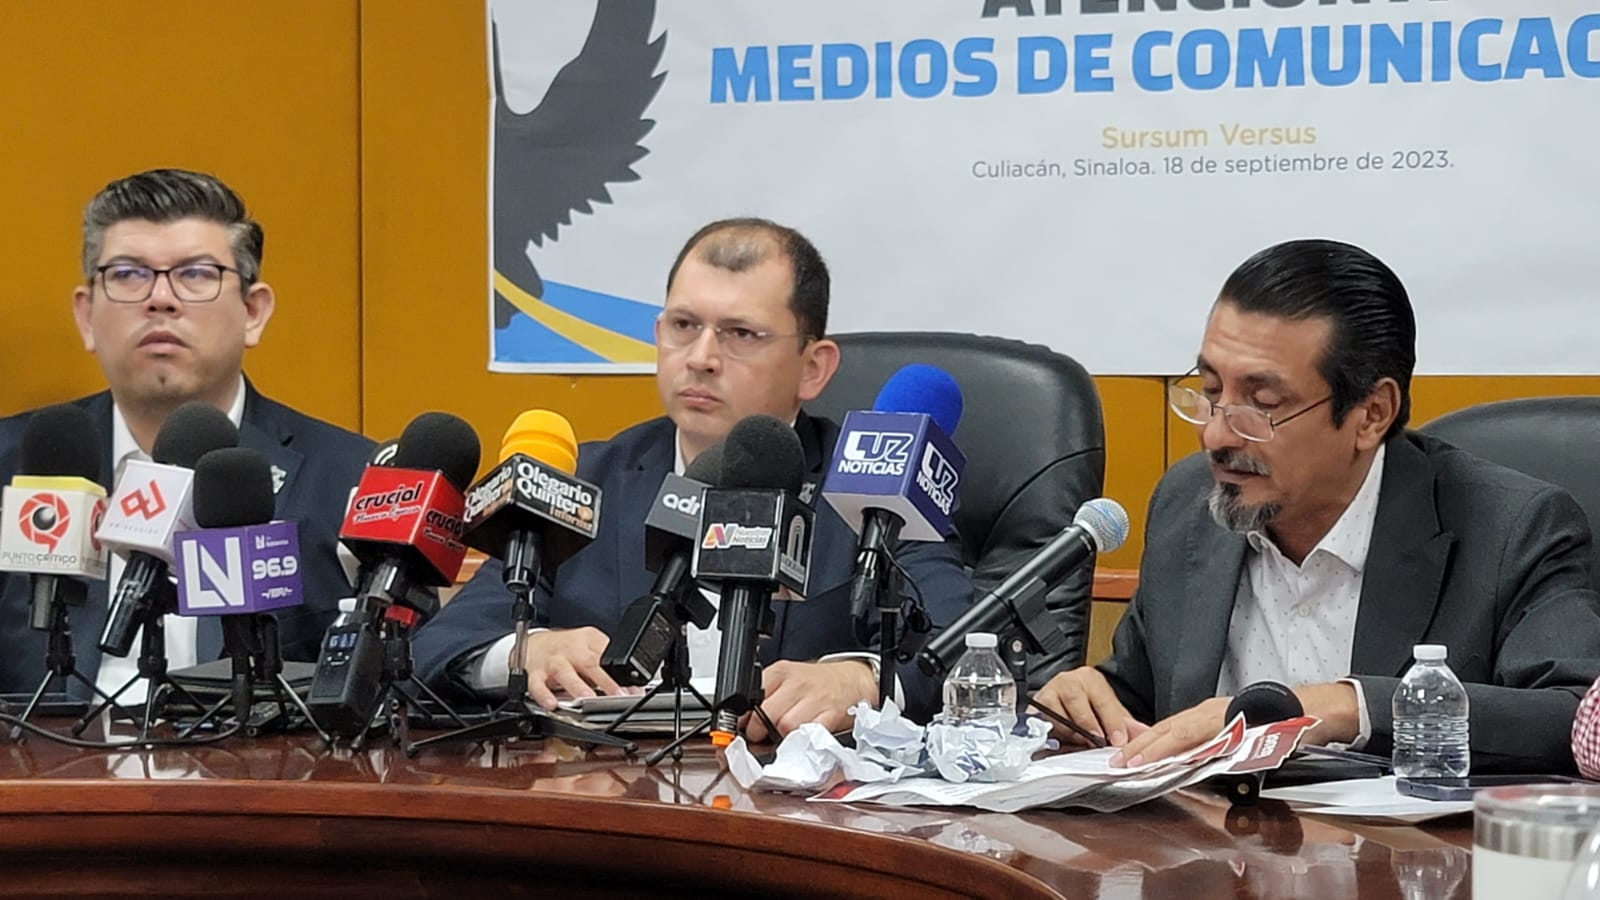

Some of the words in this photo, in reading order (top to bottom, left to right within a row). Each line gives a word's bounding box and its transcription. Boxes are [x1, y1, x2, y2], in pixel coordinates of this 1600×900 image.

[710, 38, 998, 103] MEDIOS
[1017, 33, 1114, 95] DE
[1102, 126, 1208, 149] Sursum
[1220, 123, 1317, 146] Versus
[972, 157, 1067, 179] Culiacán,
[1073, 157, 1156, 177] Sinaloa.
[1163, 157, 1183, 174] 18
[1190, 155, 1217, 174] de
[1224, 151, 1348, 176] septiembre
[1356, 152, 1384, 170] de
[1392, 149, 1454, 169] 2023.
[838, 460, 906, 476] NOTICIAS
[517, 462, 592, 506] Olegario
[252, 555, 298, 580] 96.9
